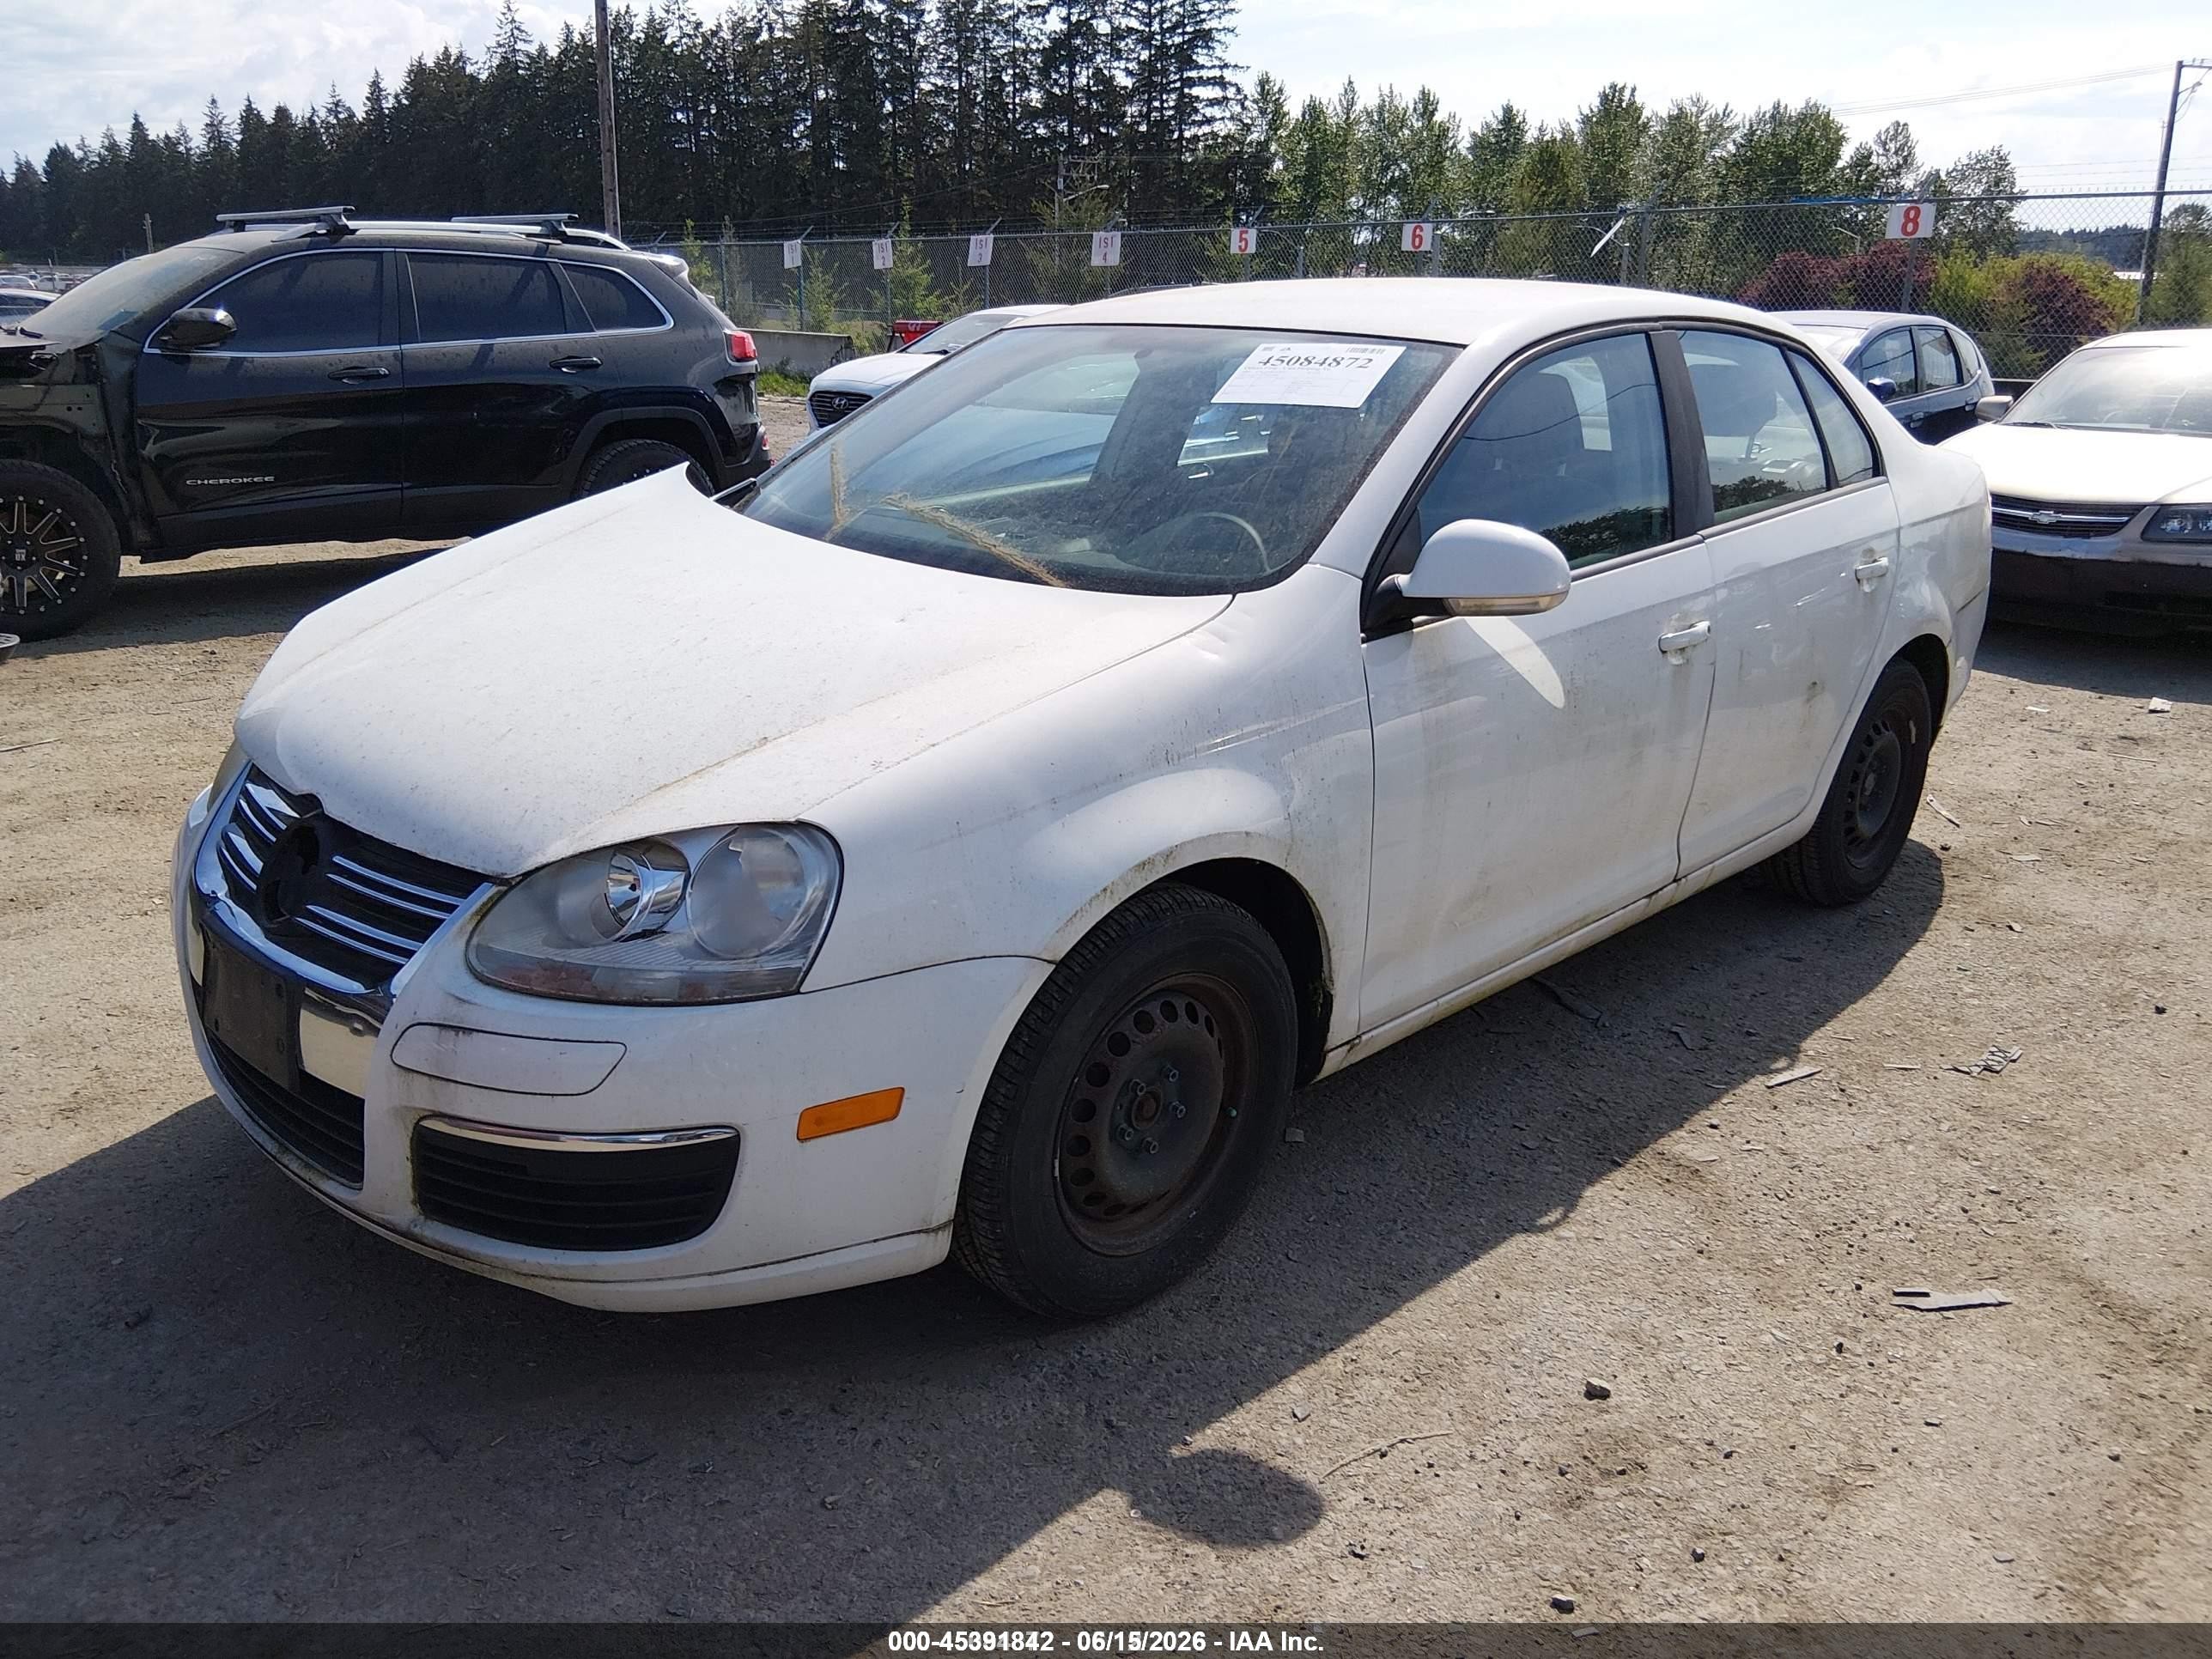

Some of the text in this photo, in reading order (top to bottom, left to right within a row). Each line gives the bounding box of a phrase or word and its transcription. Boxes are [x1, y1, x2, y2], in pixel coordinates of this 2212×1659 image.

[1900, 205, 1921, 237] 8
[1238, 229, 1249, 252] 5
[1411, 224, 1424, 250] 6
[1102, 251, 1108, 264] 4
[1258, 356, 1374, 368] 45084872
[185, 476, 276, 486] CHEROKEE
